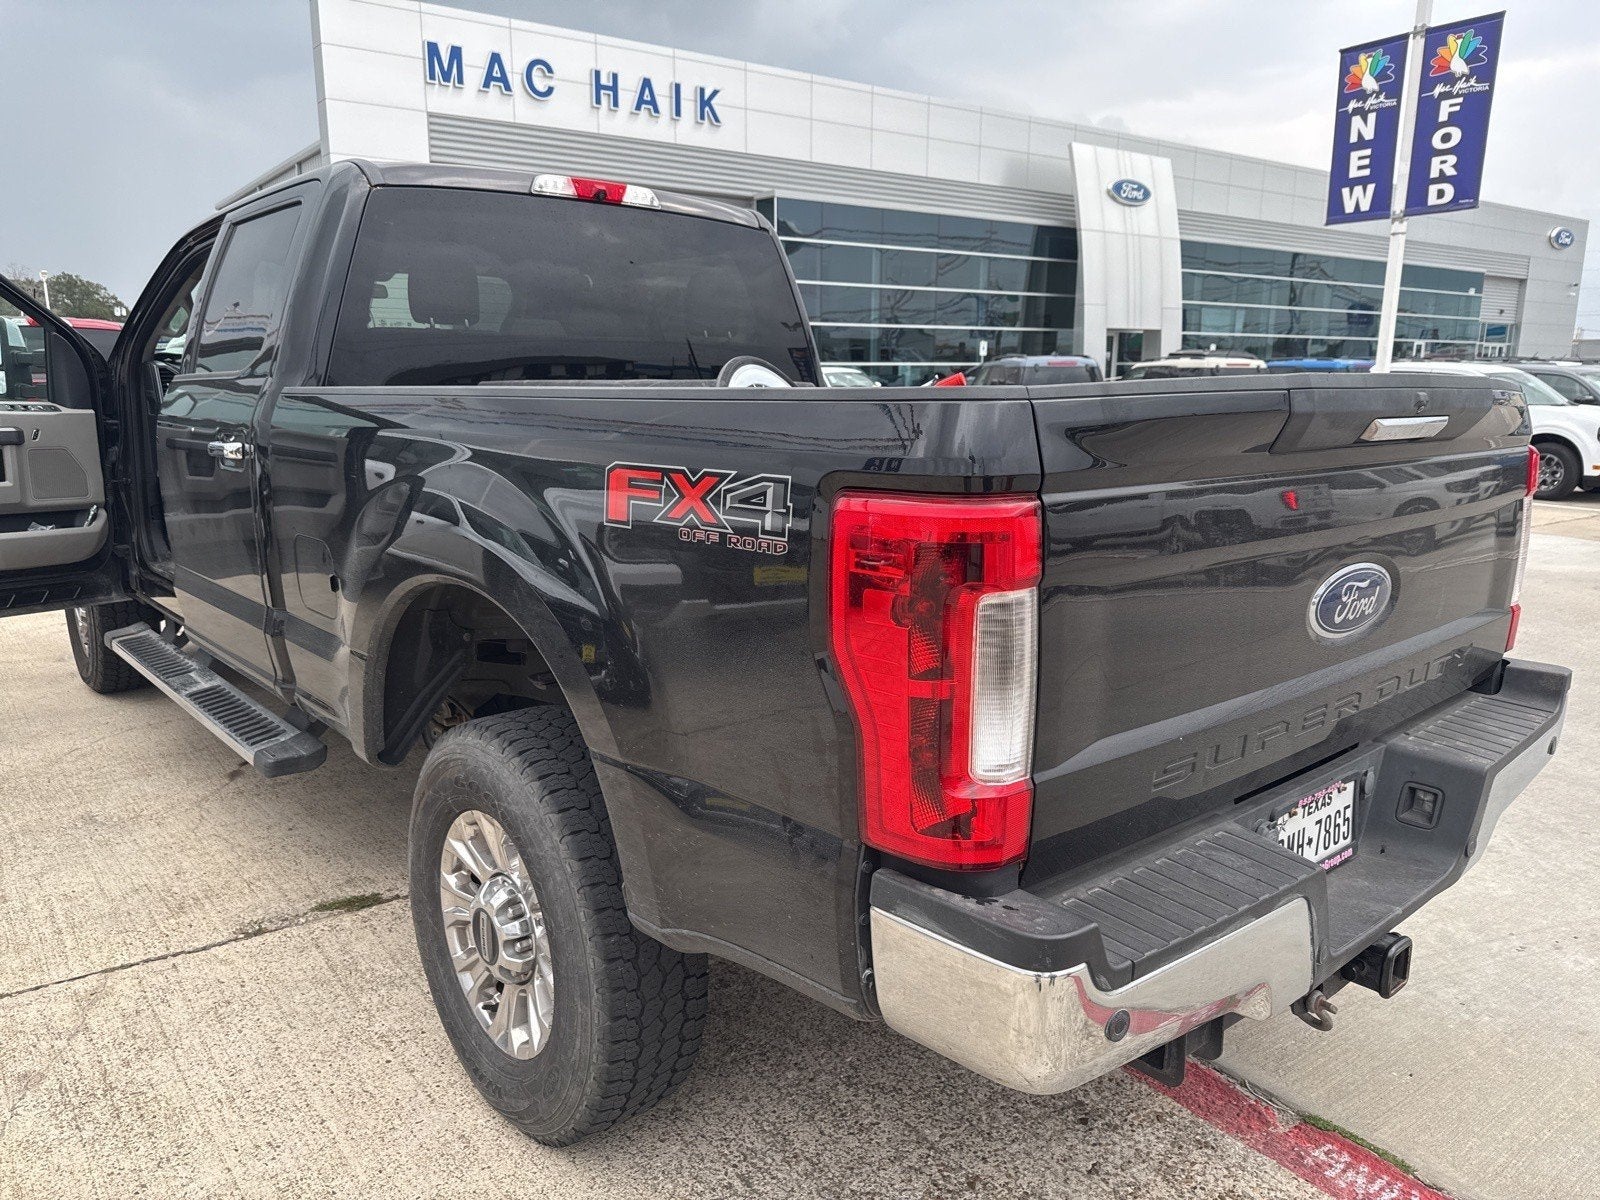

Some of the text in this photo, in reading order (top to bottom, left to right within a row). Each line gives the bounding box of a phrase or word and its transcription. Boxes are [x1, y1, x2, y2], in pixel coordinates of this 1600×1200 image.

[424, 39, 722, 126] MAC HAIK
[1458, 85, 1490, 95] VICTORIA
[1369, 101, 1397, 111] VICTORIA
[1341, 111, 1377, 214] NEW
[1427, 97, 1464, 206] FORD
[1120, 182, 1145, 200] Ford
[604, 461, 793, 541] FX4
[678, 527, 789, 556] OFF ROAD
[1334, 579, 1381, 625] Ford
[1151, 690, 1363, 794] SUPER
[1301, 791, 1333, 819] TEXAS
